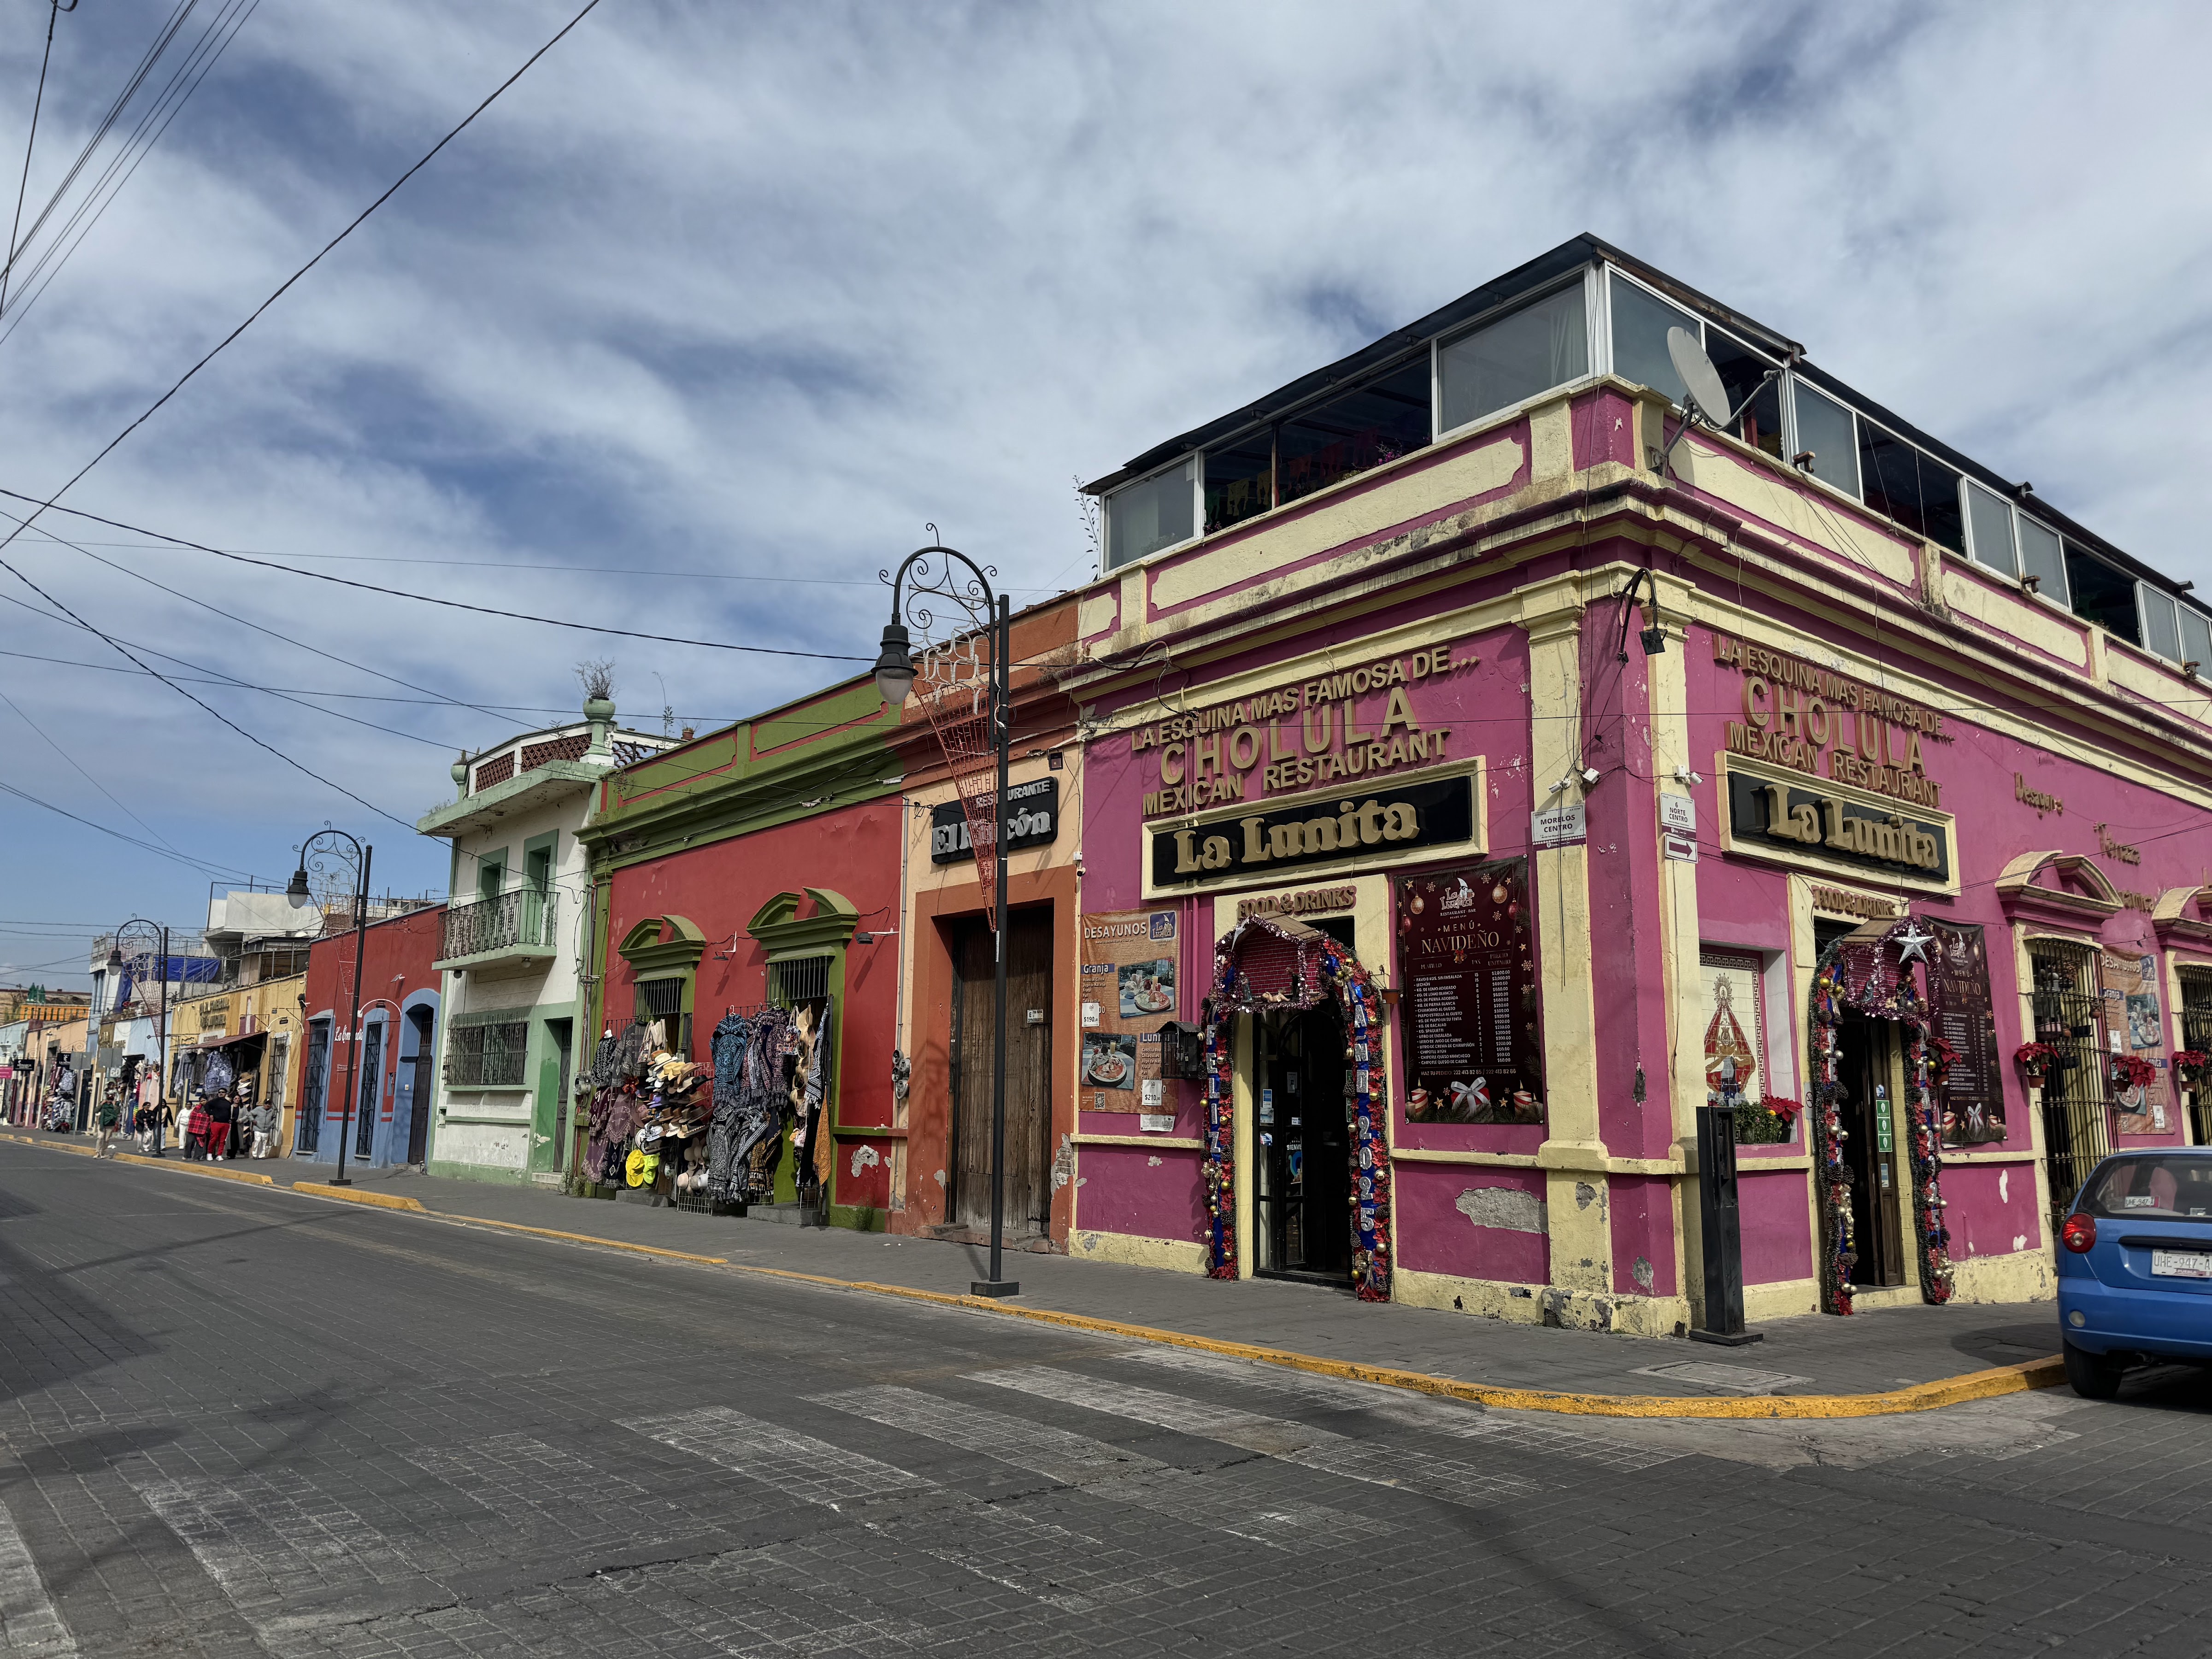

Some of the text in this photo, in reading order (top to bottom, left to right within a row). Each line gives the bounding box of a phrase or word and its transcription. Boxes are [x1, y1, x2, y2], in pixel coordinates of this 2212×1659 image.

[1713, 634, 1742, 666] LA
[1744, 645, 1822, 695] ESQUINA
[1823, 673, 1859, 706] MAS
[1860, 687, 1922, 730] FAMOSA
[1131, 727, 1158, 751] LA
[1159, 703, 1249, 744] ESQUINA
[1251, 688, 1300, 721] MAS
[1304, 659, 1410, 707] FAMOSA
[1160, 686, 1420, 784] CHOLULA
[1741, 676, 1926, 777] CHOLULA
[1143, 727, 1451, 815] MEXICAN RESTAURANT
[1724, 720, 1942, 806] MEXICAN RESTAURANT
[976, 780, 1054, 807] RESURANTE
[1541, 815, 1575, 825] MORELOS
[1669, 814, 1688, 822] CENTRO
[1670, 807, 1686, 816] NORTE
[1174, 800, 1420, 873] La Lunita
[1544, 824, 1572, 832] CENTRO
[1765, 783, 1939, 868] La Lunita
[932, 824, 958, 855] El
[1237, 888, 1354, 920] FOOD & DRINKS
[1445, 888, 1458, 900] La
[1084, 922, 1147, 939] DESAYUNOS
[1443, 920, 1474, 932] MENÚ
[1421, 930, 1499, 954] NAVIDEÑO
[1084, 962, 1108, 975] Granja
[1944, 979, 1981, 995] NAVIDEÑO
[335, 1026, 342, 1041] La
[1206, 1025, 1220, 1153] FELIZ
[1358, 1116, 1374, 1232] 2025
[2154, 1255, 2211, 1270] UHE-947-A
